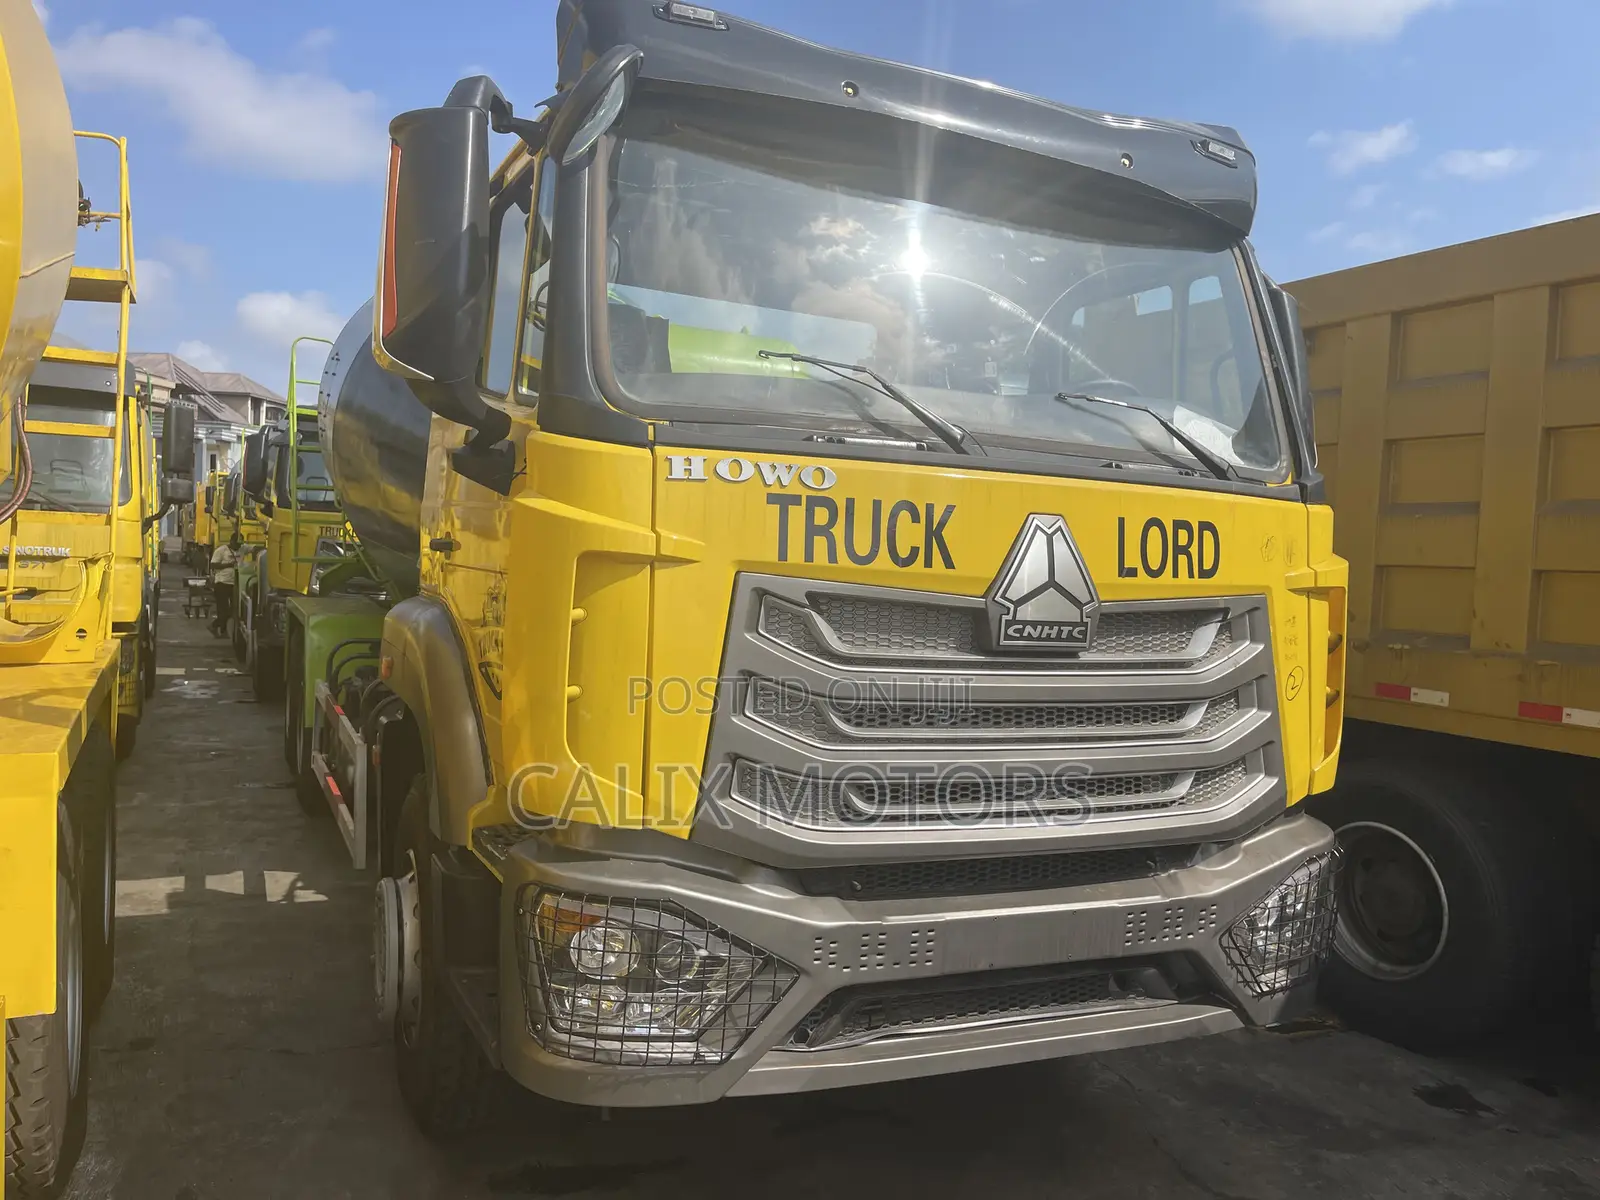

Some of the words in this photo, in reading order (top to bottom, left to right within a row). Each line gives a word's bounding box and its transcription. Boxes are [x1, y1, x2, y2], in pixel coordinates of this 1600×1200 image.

[666, 455, 837, 490] HOWO
[766, 493, 956, 569] TRUCK
[1117, 516, 1220, 579] LORD
[2, 545, 71, 557] SNOTRUK
[1006, 624, 1086, 639] CNHTC
